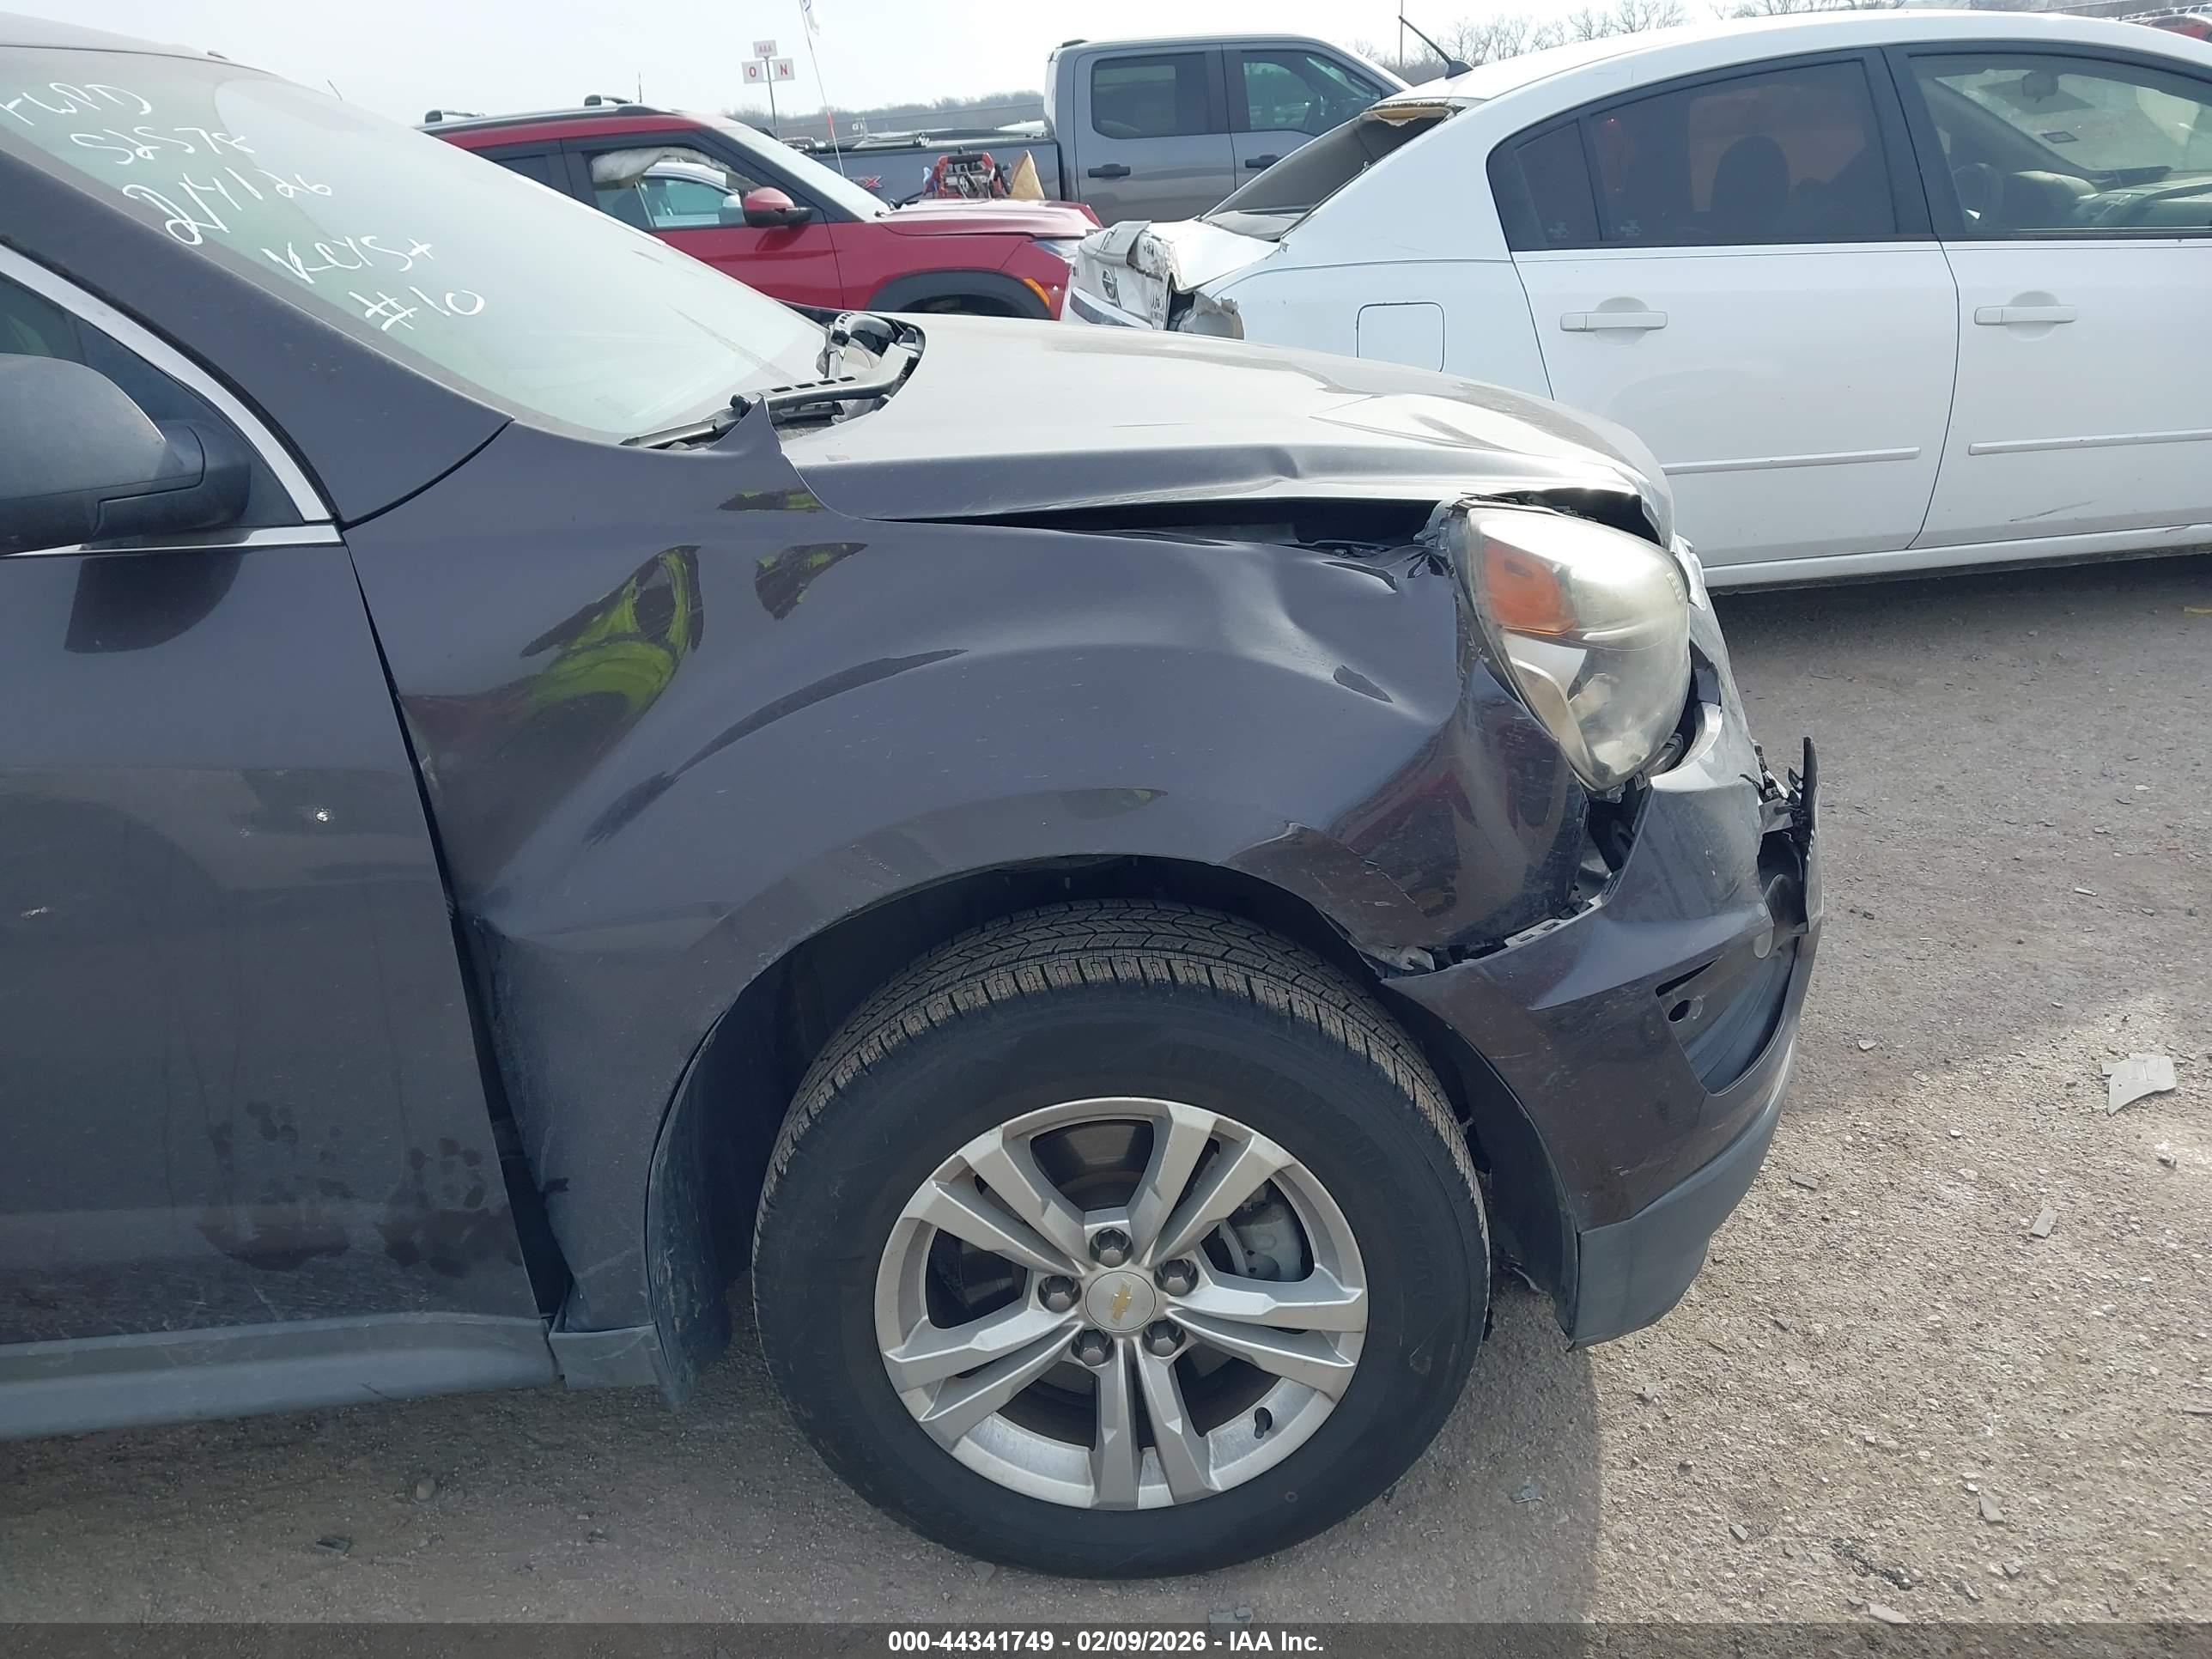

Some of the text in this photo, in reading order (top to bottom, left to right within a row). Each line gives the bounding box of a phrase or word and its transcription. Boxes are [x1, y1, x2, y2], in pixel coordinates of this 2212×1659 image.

[749, 66, 757, 78] O
[780, 64, 788, 76] N
[348, 285, 486, 331] #10
